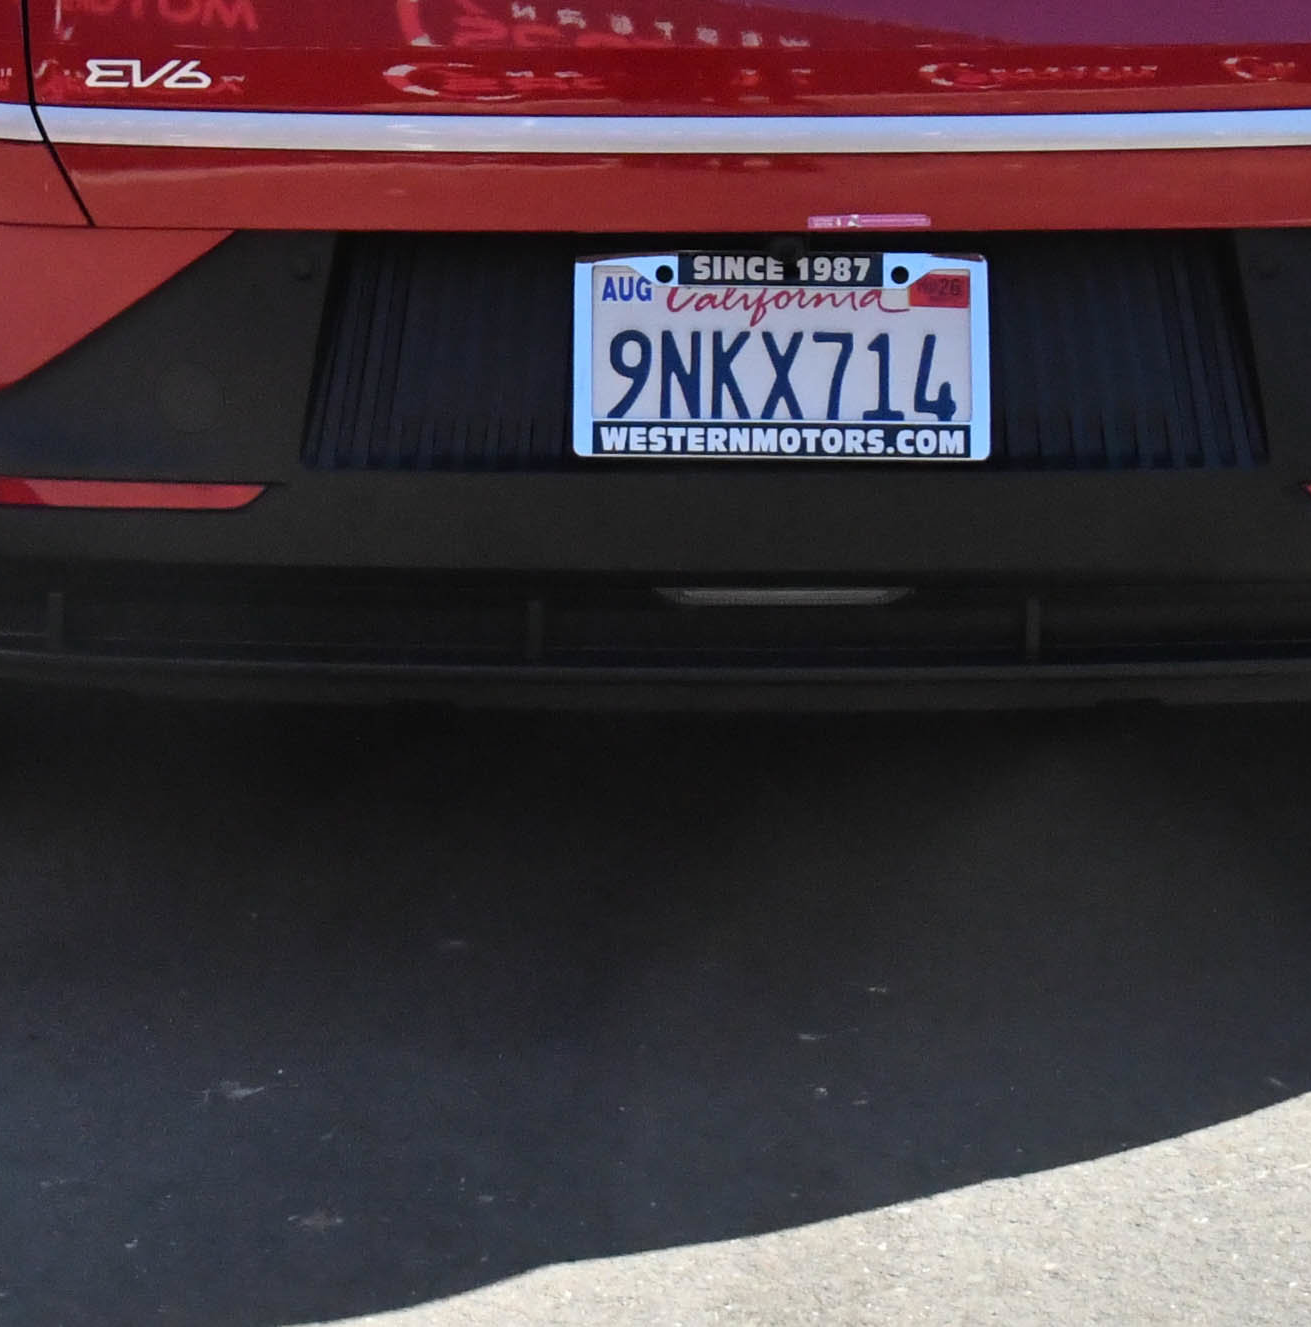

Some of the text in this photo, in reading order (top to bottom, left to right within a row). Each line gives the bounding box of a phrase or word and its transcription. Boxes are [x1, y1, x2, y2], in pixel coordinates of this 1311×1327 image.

[85, 59, 212, 88] EV6
[693, 255, 871, 282] SINCE 1987
[601, 276, 652, 301] AUG
[666, 286, 910, 327] California
[606, 328, 957, 422] 9NKX714
[599, 425, 965, 455] WESTERNMOTORS.COM
